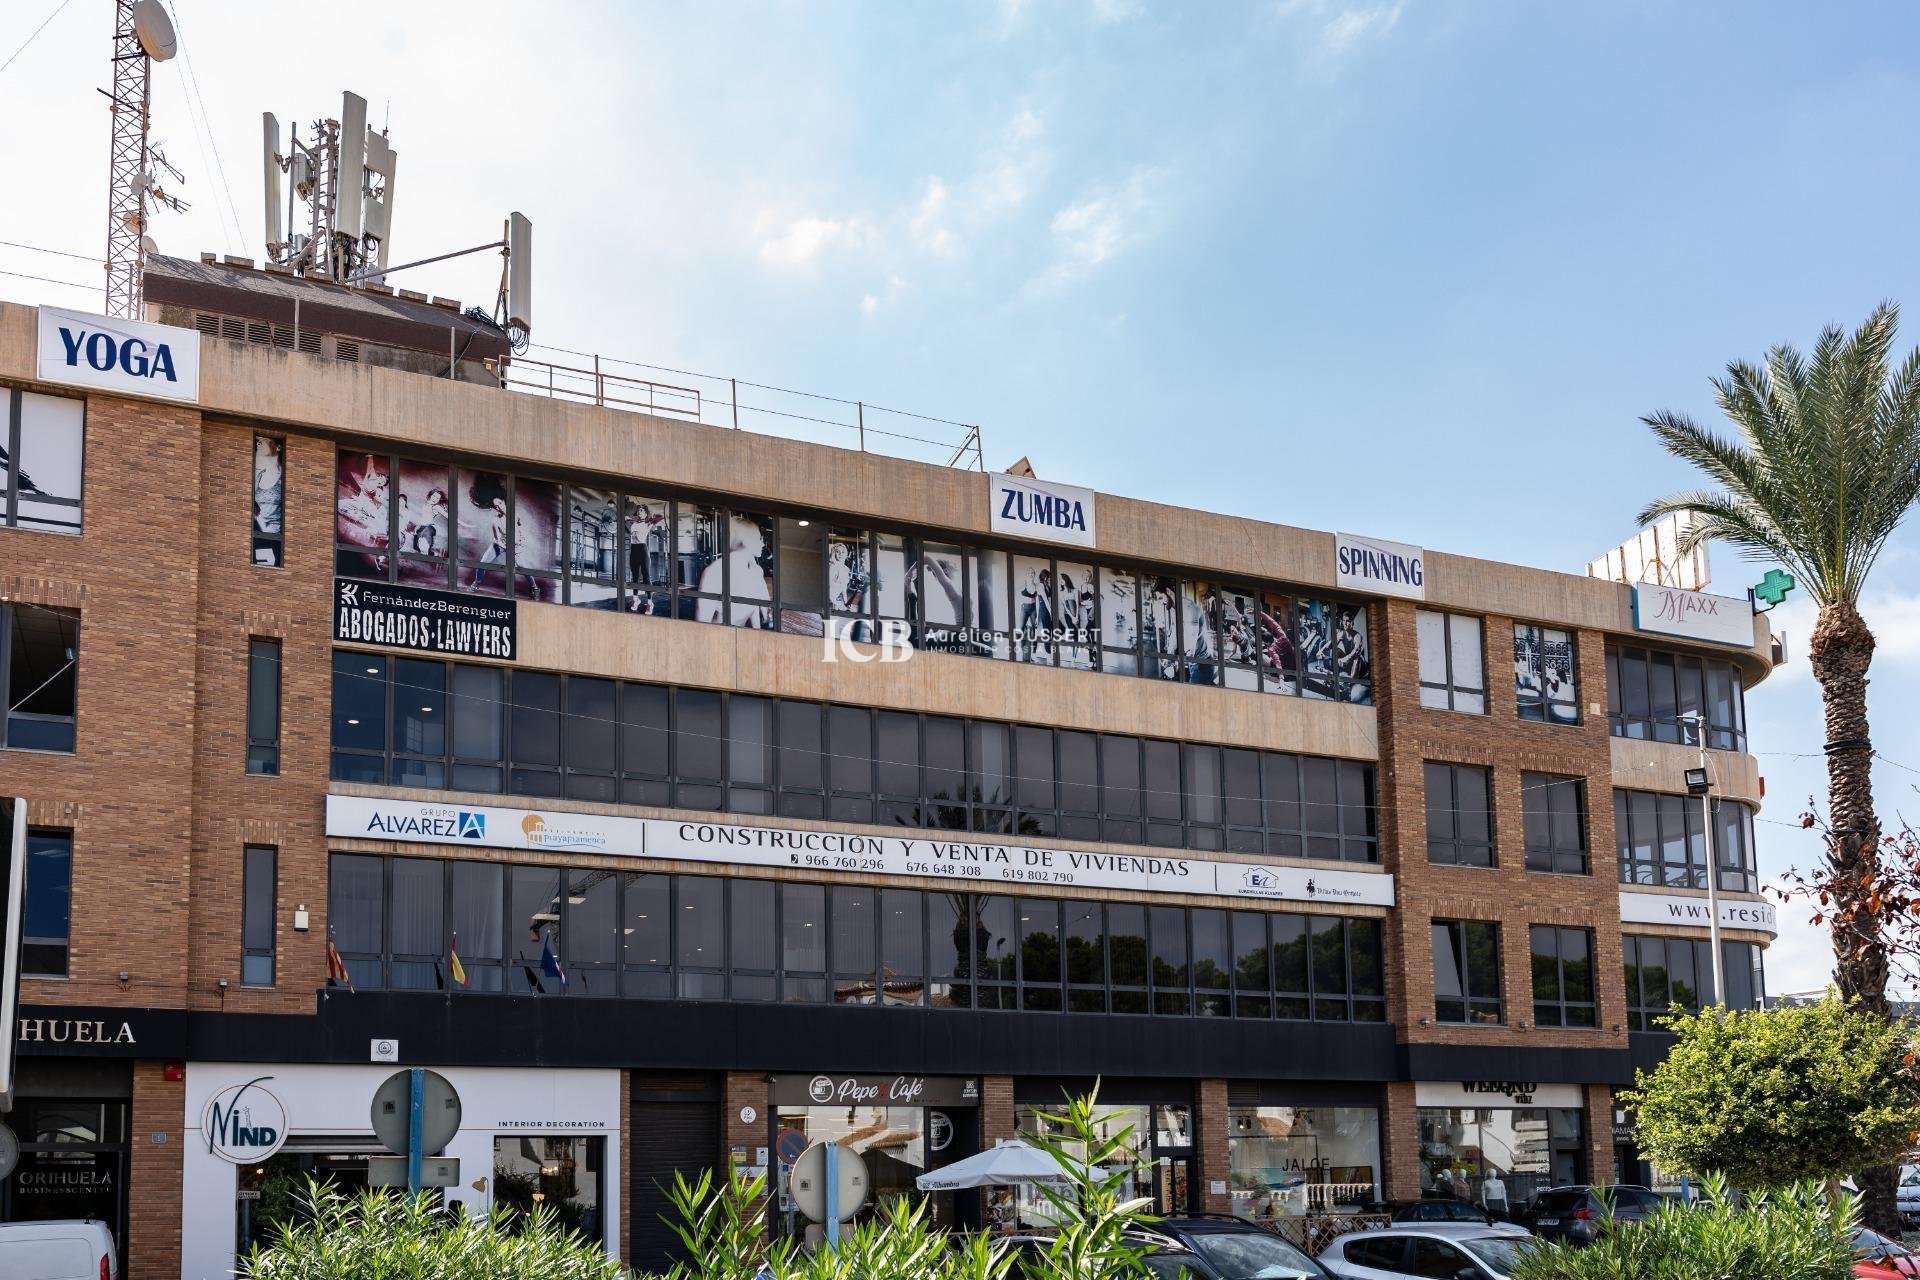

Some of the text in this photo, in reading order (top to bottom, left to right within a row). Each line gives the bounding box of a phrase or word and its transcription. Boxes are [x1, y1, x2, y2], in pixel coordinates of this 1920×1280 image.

[58, 327, 177, 382] YOGA
[1001, 488, 1086, 531] ZUMBA
[1339, 546, 1423, 587] SPINNING
[363, 591, 511, 619] FernándezBerenguer
[367, 811, 456, 837] ALVAREZ
[420, 808, 456, 818] GRUPO
[679, 824, 1190, 877] CONSTRUCCIÓN Y VENTA DE VIVIENDAS
[805, 854, 1074, 883] 966 760 296 676 648 308 619 802 790
[19, 1019, 137, 1043] HUELA
[889, 1076, 924, 1102] Café
[19, 1171, 113, 1185] ORIHUELA
